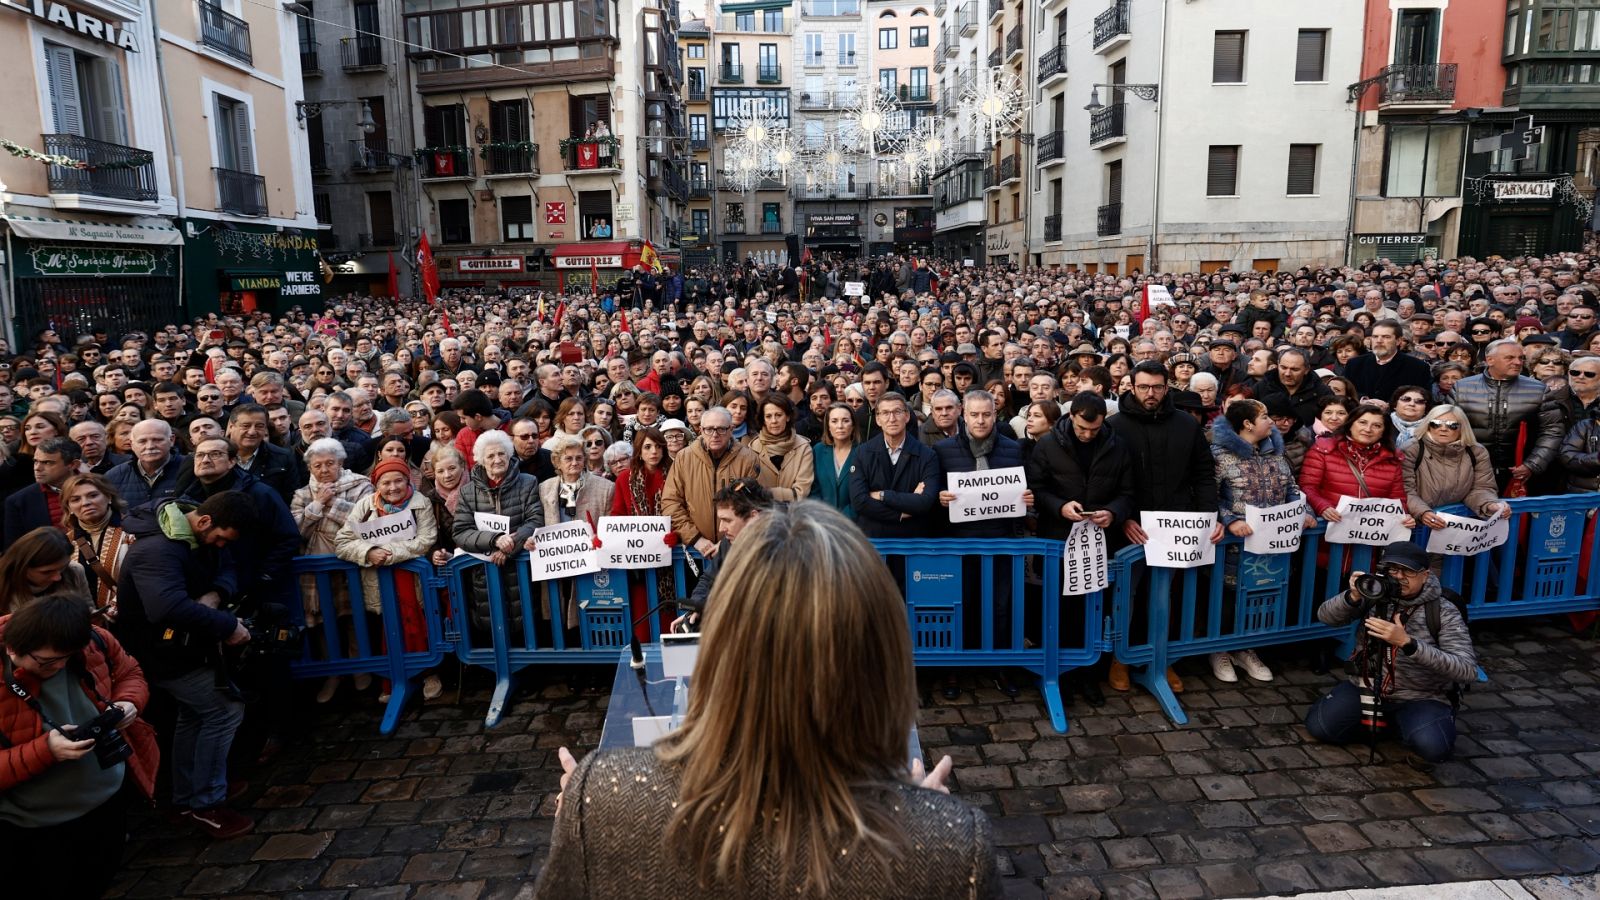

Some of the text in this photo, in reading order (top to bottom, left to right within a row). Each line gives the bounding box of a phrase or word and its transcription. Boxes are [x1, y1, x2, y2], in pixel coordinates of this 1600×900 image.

[1496, 184, 1551, 197] FARMACIA
[1359, 235, 1425, 245] GUTIERREZ
[468, 260, 512, 269] GUTIERREZ
[565, 256, 613, 266] GUTIEREZ
[238, 278, 281, 289] VIANDAS
[281, 285, 320, 296] FARMERS
[957, 474, 1021, 488] PAMPLONA
[981, 492, 999, 501] NO
[964, 504, 1016, 517] SE VENDE
[1348, 503, 1404, 515] TRAICIÓN
[1156, 517, 1211, 529] TRAICIÓN
[1359, 517, 1385, 527] POR
[606, 523, 666, 533] PAMPLONA
[1277, 522, 1299, 535] POR
[534, 527, 590, 543] MEMORIA,
[1174, 535, 1199, 545] POR
[1347, 530, 1389, 541] SILLÓN
[1471, 533, 1488, 543] NO
[627, 539, 644, 548] NO
[1269, 535, 1301, 549] SILLÓ
[1445, 535, 1499, 553] SE VENDE
[538, 542, 592, 558] DIGNIDAD,
[610, 553, 662, 563] SE VENDE
[1093, 526, 1105, 587] SOE=BILDU
[1167, 550, 1203, 562] SILLÓN
[545, 558, 587, 573] JUSTICIA
